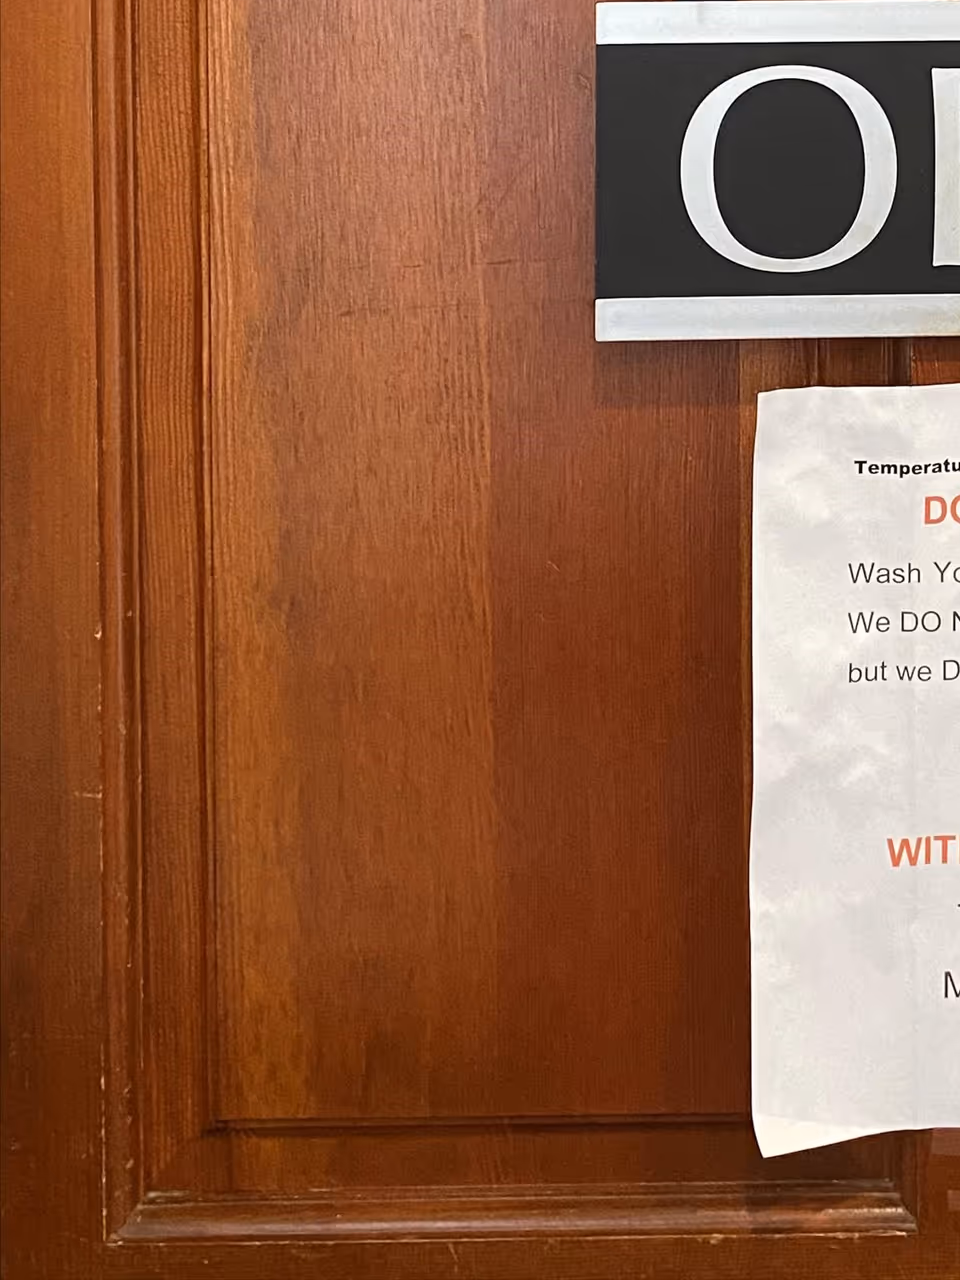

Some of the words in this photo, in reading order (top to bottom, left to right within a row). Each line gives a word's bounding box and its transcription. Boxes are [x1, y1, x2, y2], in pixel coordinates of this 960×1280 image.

[849, 563, 920, 583] Wash
[848, 612, 890, 633] We
[901, 611, 941, 632] DO
[849, 661, 887, 683] but
[896, 666, 931, 681] we
